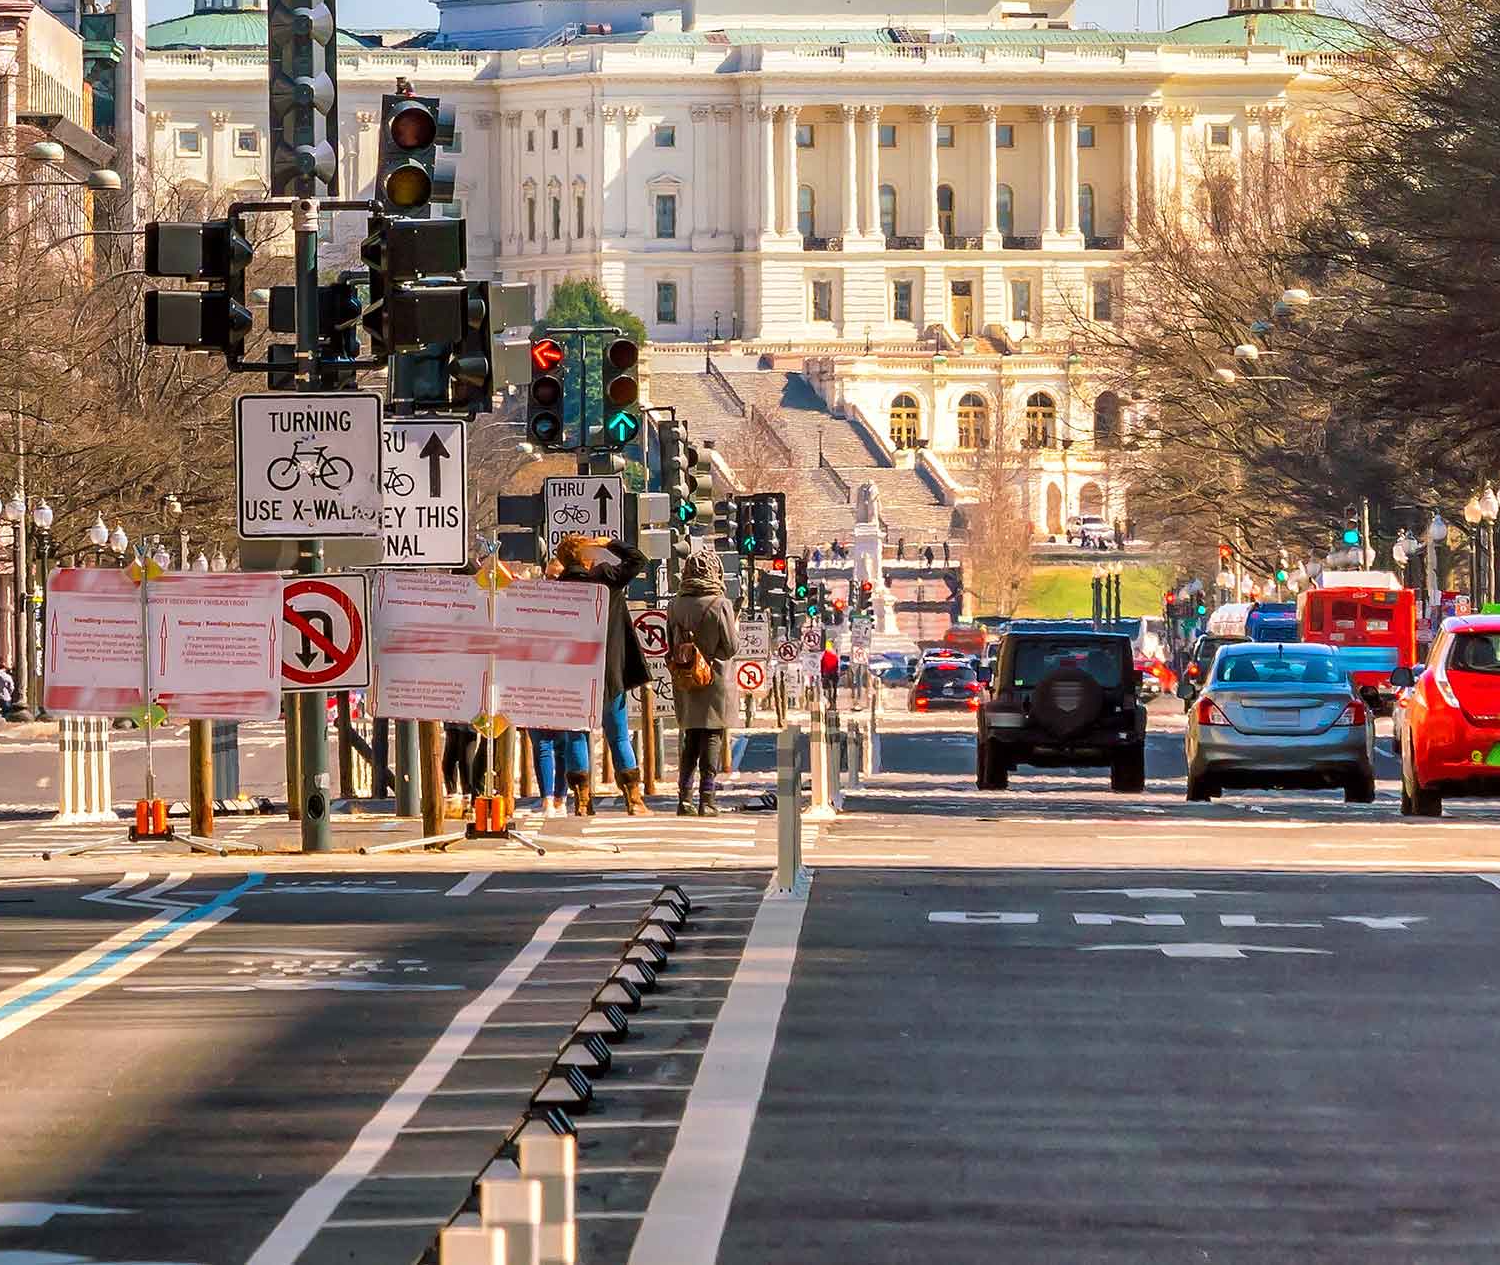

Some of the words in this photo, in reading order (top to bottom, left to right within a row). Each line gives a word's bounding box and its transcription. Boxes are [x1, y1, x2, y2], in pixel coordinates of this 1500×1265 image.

[268, 410, 351, 432] TURNING
[384, 430, 407, 453] RU
[550, 482, 585, 497] THRU
[245, 500, 283, 521] USE
[292, 499, 376, 521] X-WAL
[384, 506, 407, 529] EY
[415, 506, 459, 528] THIS
[386, 535, 425, 557] NAL
[927, 911, 1429, 930] ONLY
